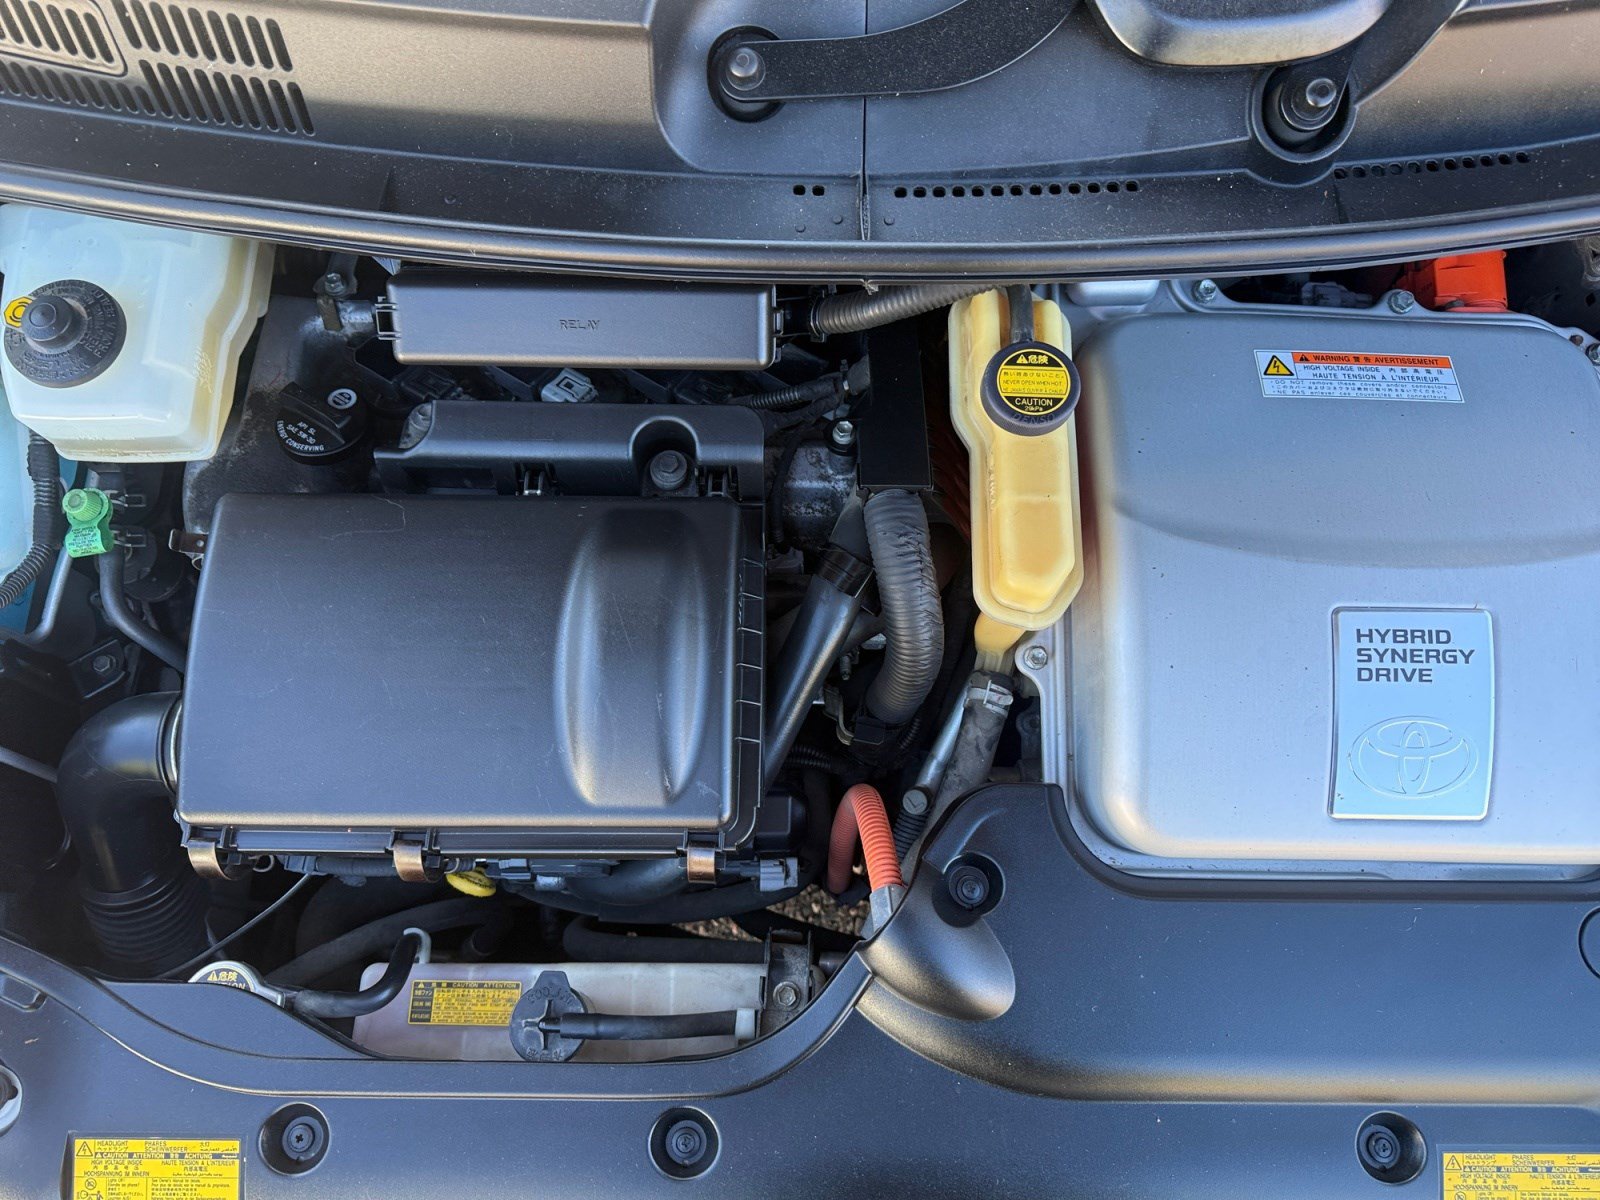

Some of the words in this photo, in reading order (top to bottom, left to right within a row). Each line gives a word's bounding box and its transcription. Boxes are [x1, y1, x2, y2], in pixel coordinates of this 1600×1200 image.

[559, 319, 600, 330] RELAY
[1028, 354, 1049, 365] 危険
[1313, 354, 1350, 362] WARNING
[1374, 356, 1440, 366] AVERTISSEMENT
[1014, 397, 1053, 407] CAUTION
[286, 423, 299, 434] SAE
[286, 438, 325, 451] CONSERVING
[1356, 628, 1452, 645] HYBRID
[1357, 648, 1476, 665] SYNERGY
[1357, 667, 1433, 683] DRIVE
[184, 1152, 213, 1160] ACHTUNG
